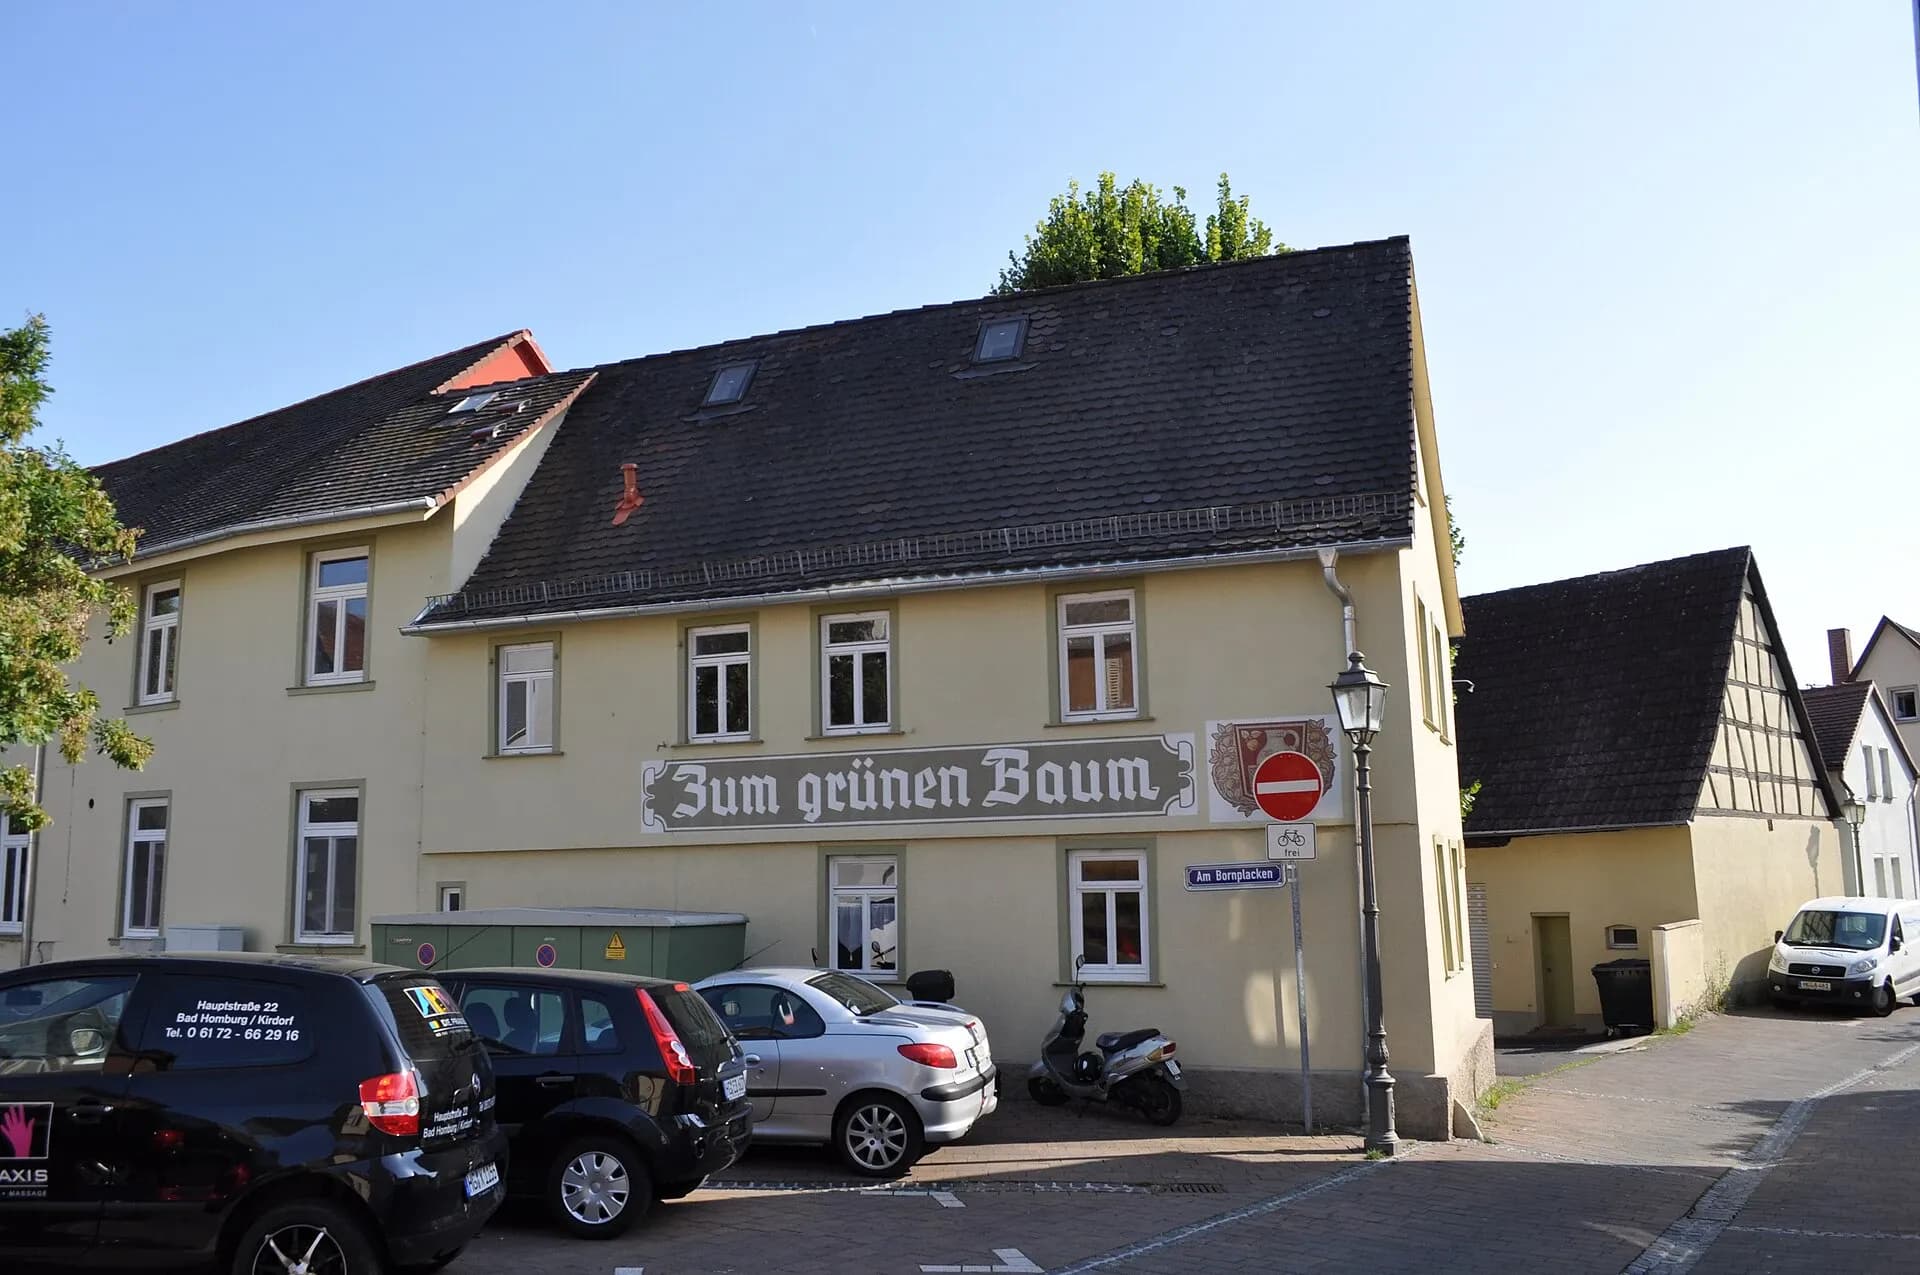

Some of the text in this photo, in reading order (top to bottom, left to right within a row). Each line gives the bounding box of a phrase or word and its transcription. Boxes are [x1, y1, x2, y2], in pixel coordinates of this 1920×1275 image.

[672, 748, 1160, 823] Zum grünen Baum
[1284, 848, 1301, 857] frei
[1197, 868, 1273, 883] Am Bornplacken
[197, 1000, 279, 1013] Hauptstraße 22
[176, 1012, 198, 1023] Bad
[200, 1013, 248, 1026] Homburg
[257, 1015, 294, 1026] Kirdorf
[165, 1027, 182, 1038] Tel.
[187, 1026, 197, 1039] 0
[199, 1027, 213, 1039] 61
[216, 1027, 233, 1039] 72
[244, 1028, 261, 1040] 66
[264, 1029, 282, 1041] 29
[285, 1029, 300, 1041] 16
[423, 1127, 435, 1139] Bad
